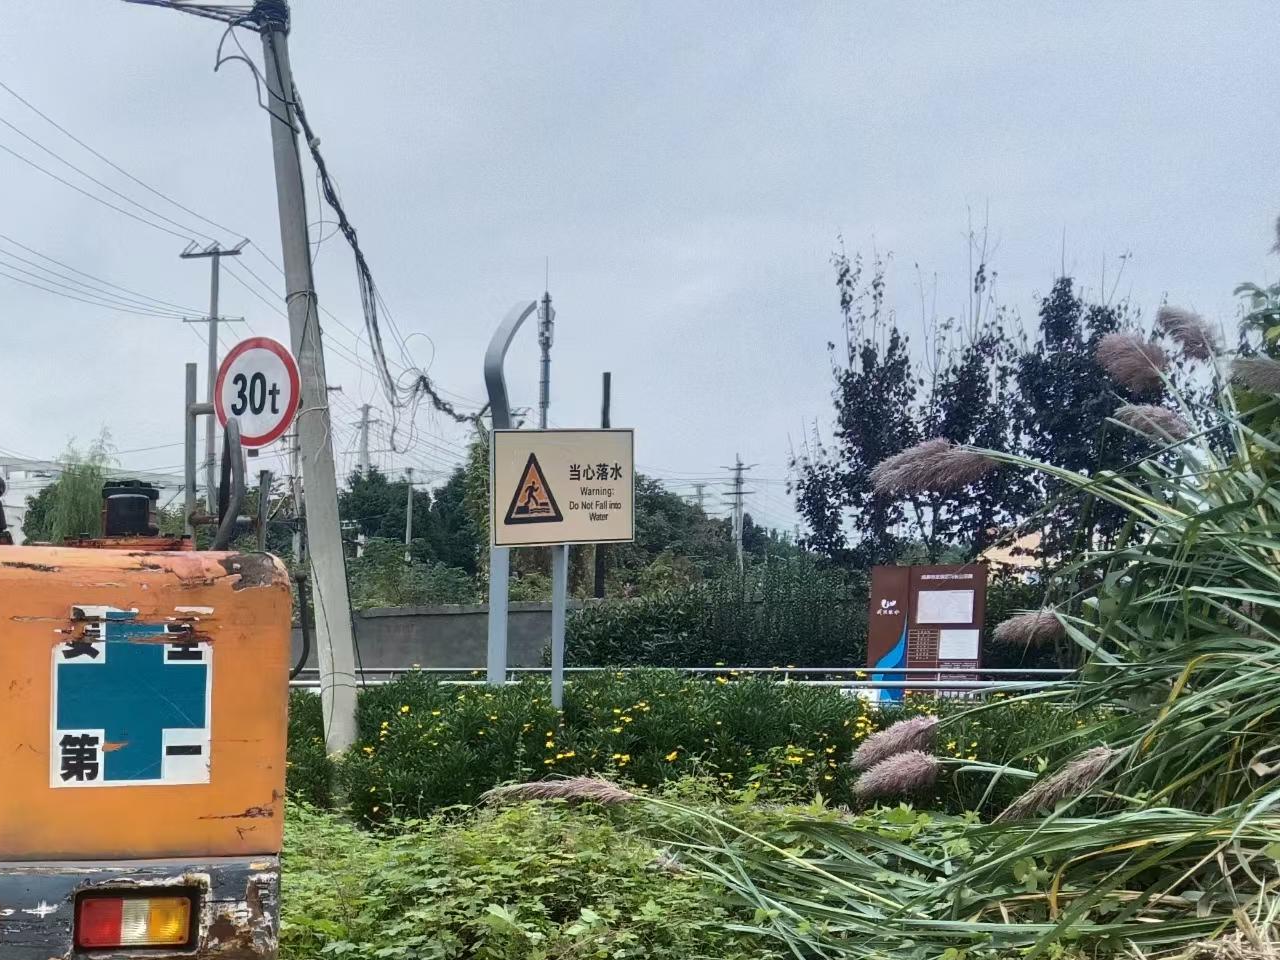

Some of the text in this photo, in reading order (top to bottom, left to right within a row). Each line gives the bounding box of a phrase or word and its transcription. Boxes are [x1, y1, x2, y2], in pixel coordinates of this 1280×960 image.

[231, 372, 280, 416] 30t
[569, 462, 623, 481] 当心落水
[580, 486, 615, 498] Warning:
[569, 501, 579, 510] Do
[581, 501, 593, 510] Not
[595, 501, 608, 510] Fall
[589, 512, 609, 521] Water
